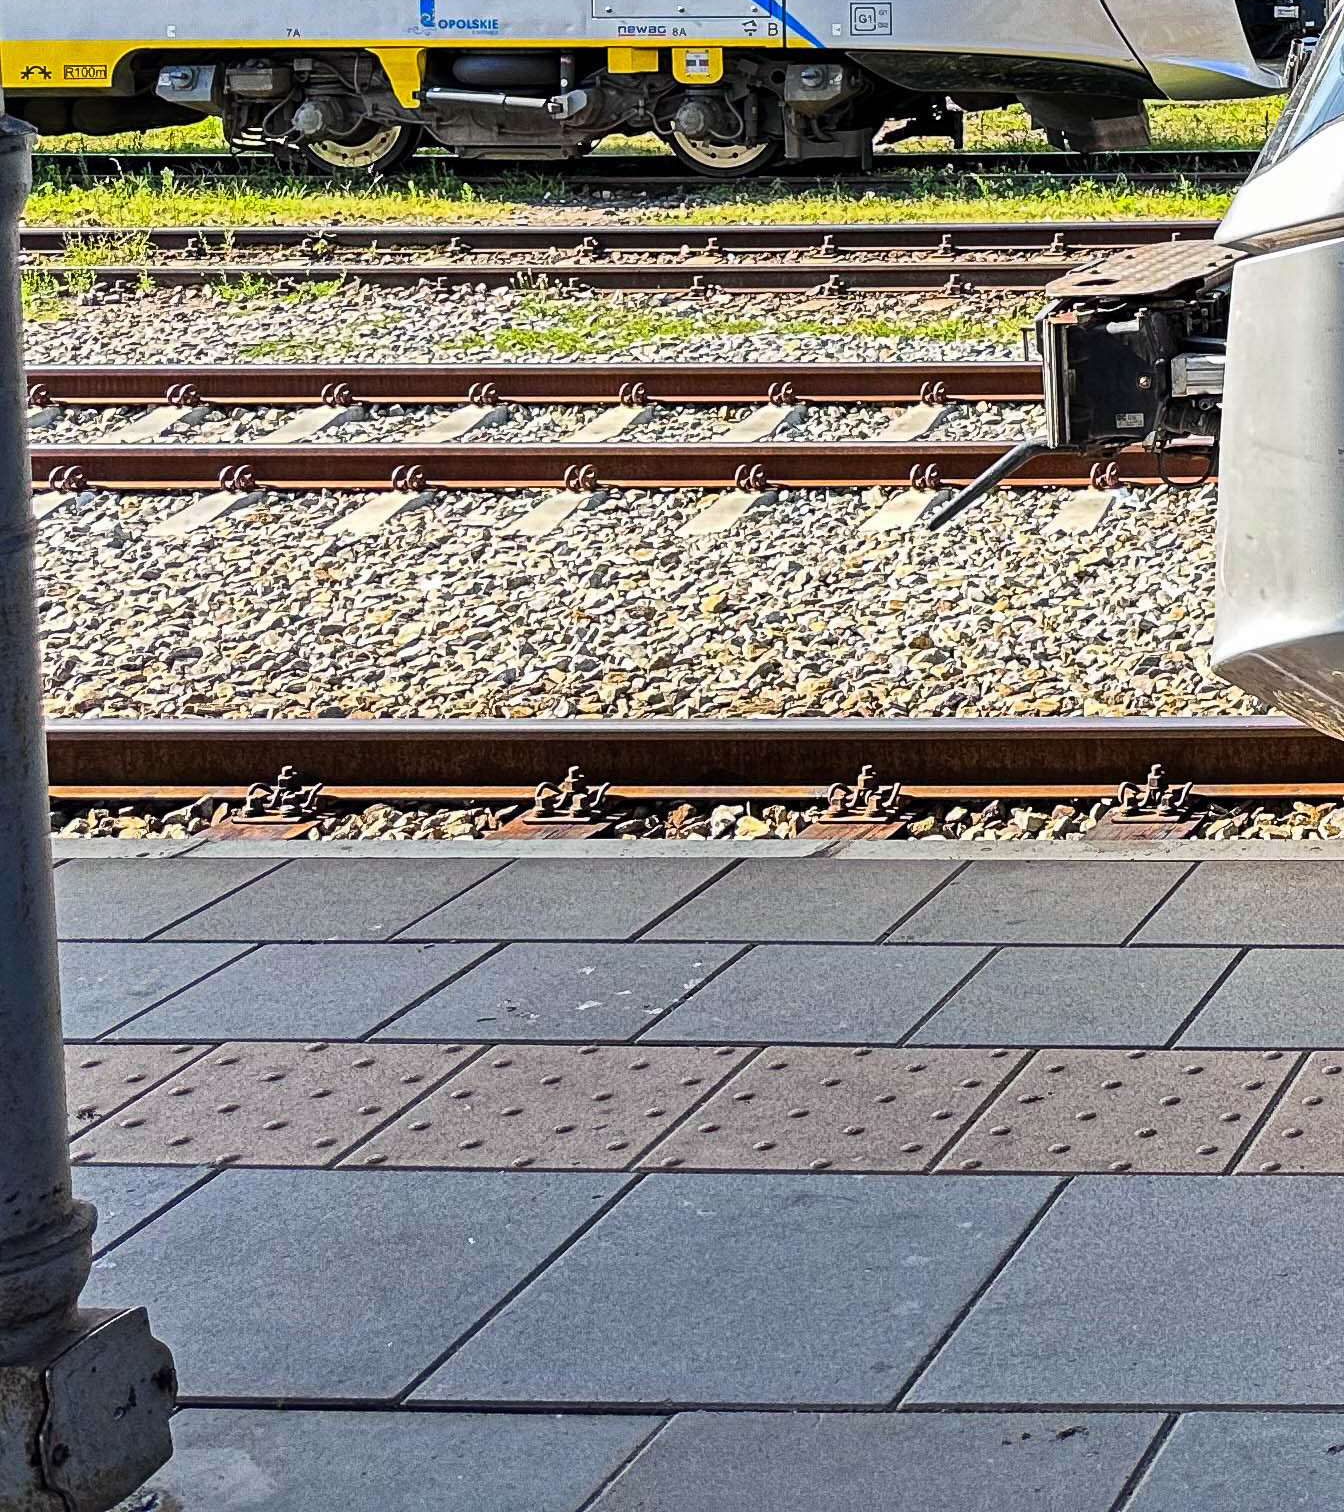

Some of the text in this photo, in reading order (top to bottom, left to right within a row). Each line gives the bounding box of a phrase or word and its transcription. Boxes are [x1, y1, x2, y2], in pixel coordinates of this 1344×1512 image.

[437, 18, 499, 30] OPOLSKIE
[858, 13, 873, 24] G1
[286, 28, 301, 38] 7A
[672, 27, 687, 37] 8A
[767, 22, 779, 37] B
[65, 66, 106, 79] R100m
